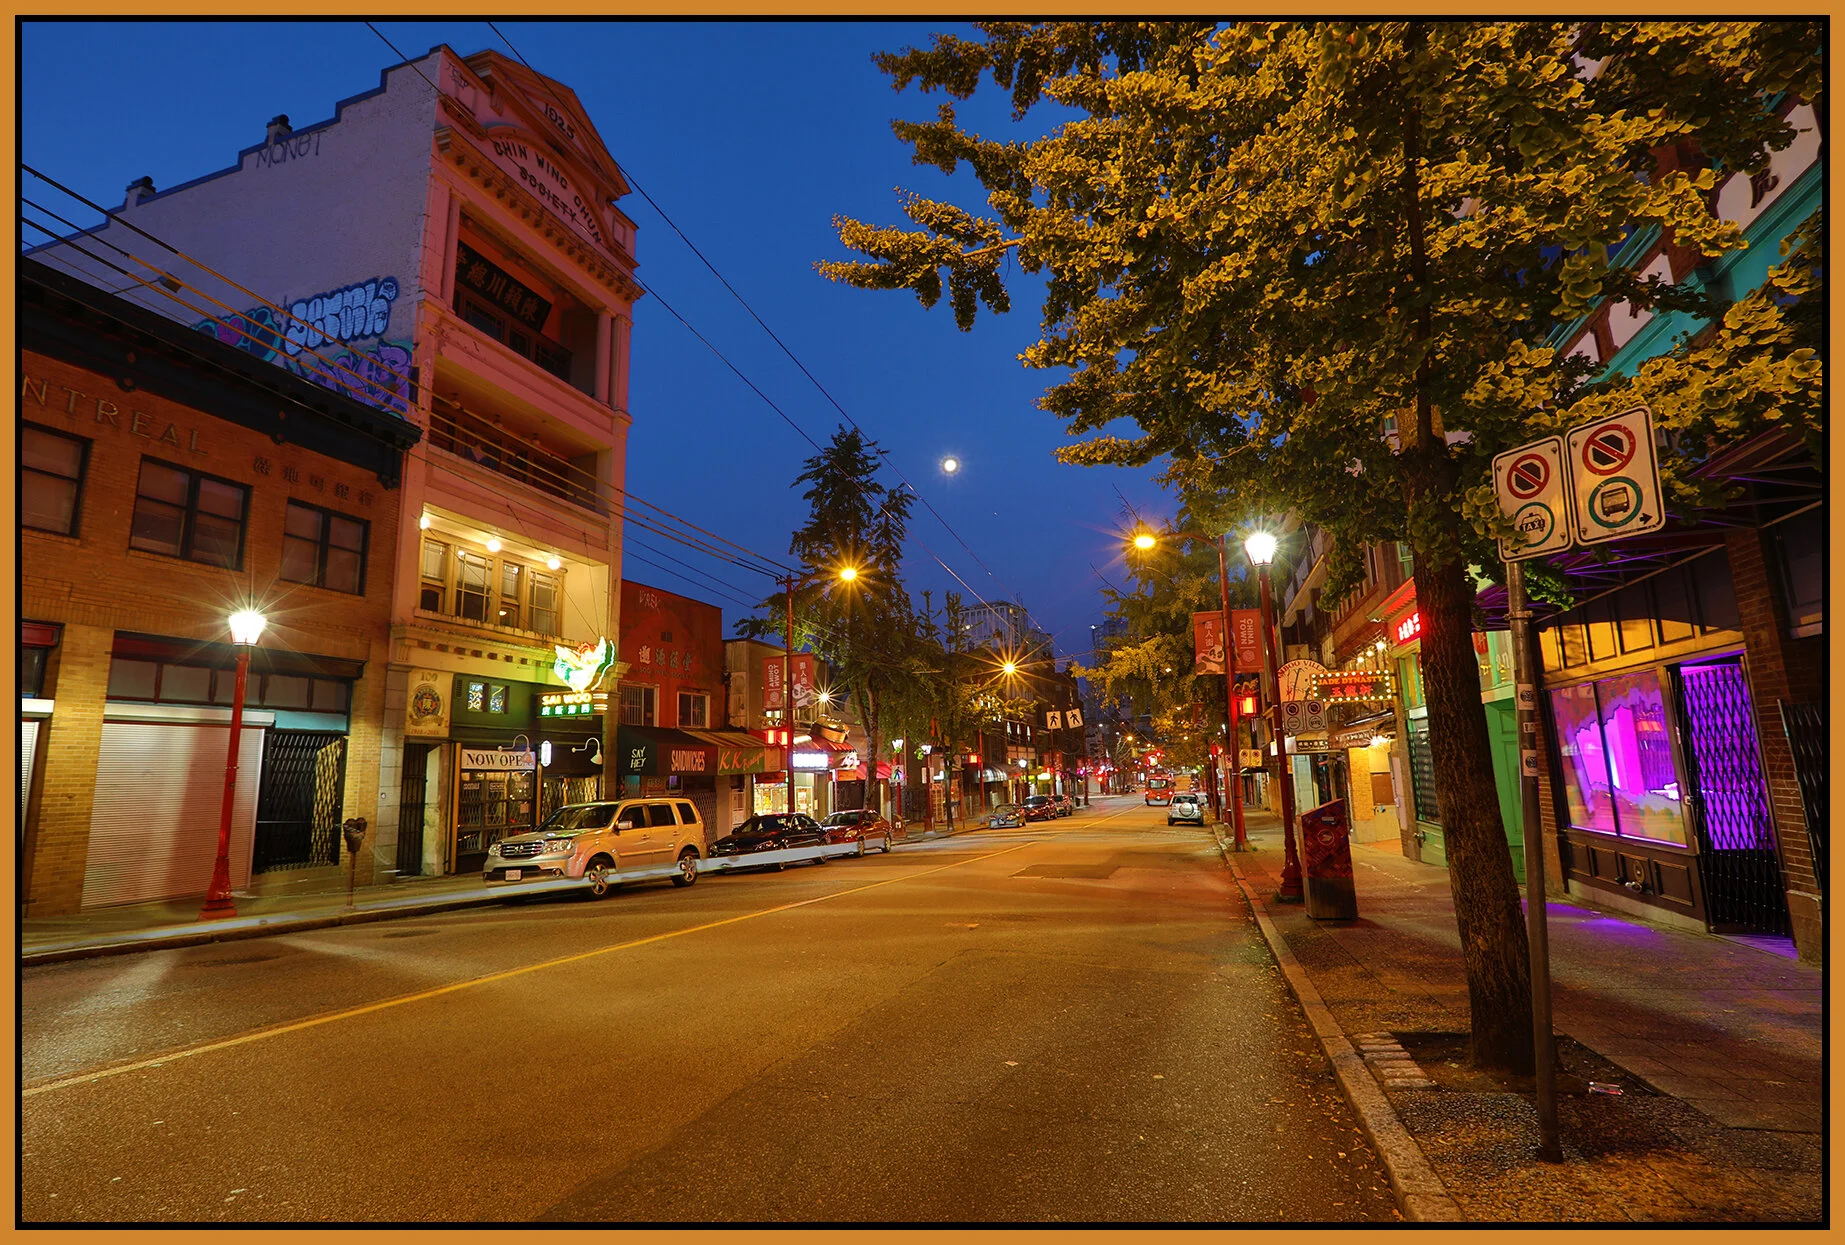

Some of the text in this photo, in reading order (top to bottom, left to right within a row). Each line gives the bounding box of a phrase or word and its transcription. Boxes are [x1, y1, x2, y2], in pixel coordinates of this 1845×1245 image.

[544, 103, 576, 139] 1925
[493, 141, 529, 161] CHIN
[573, 195, 602, 243] CHUN
[519, 165, 577, 222] SOCIETY
[1240, 618, 1248, 645] TOWN
[1246, 618, 1255, 645] CHINA
[1278, 661, 1300, 678] MBOO
[1341, 676, 1383, 684] DYNASTY
[542, 693, 592, 705] SAI WOO
[467, 753, 533, 767] NOW OPE
[631, 746, 646, 758] SAY
[671, 750, 705, 772] SANDWICHES
[719, 751, 730, 770] K
[731, 750, 743, 770] K
[630, 758, 646, 769] HEY
